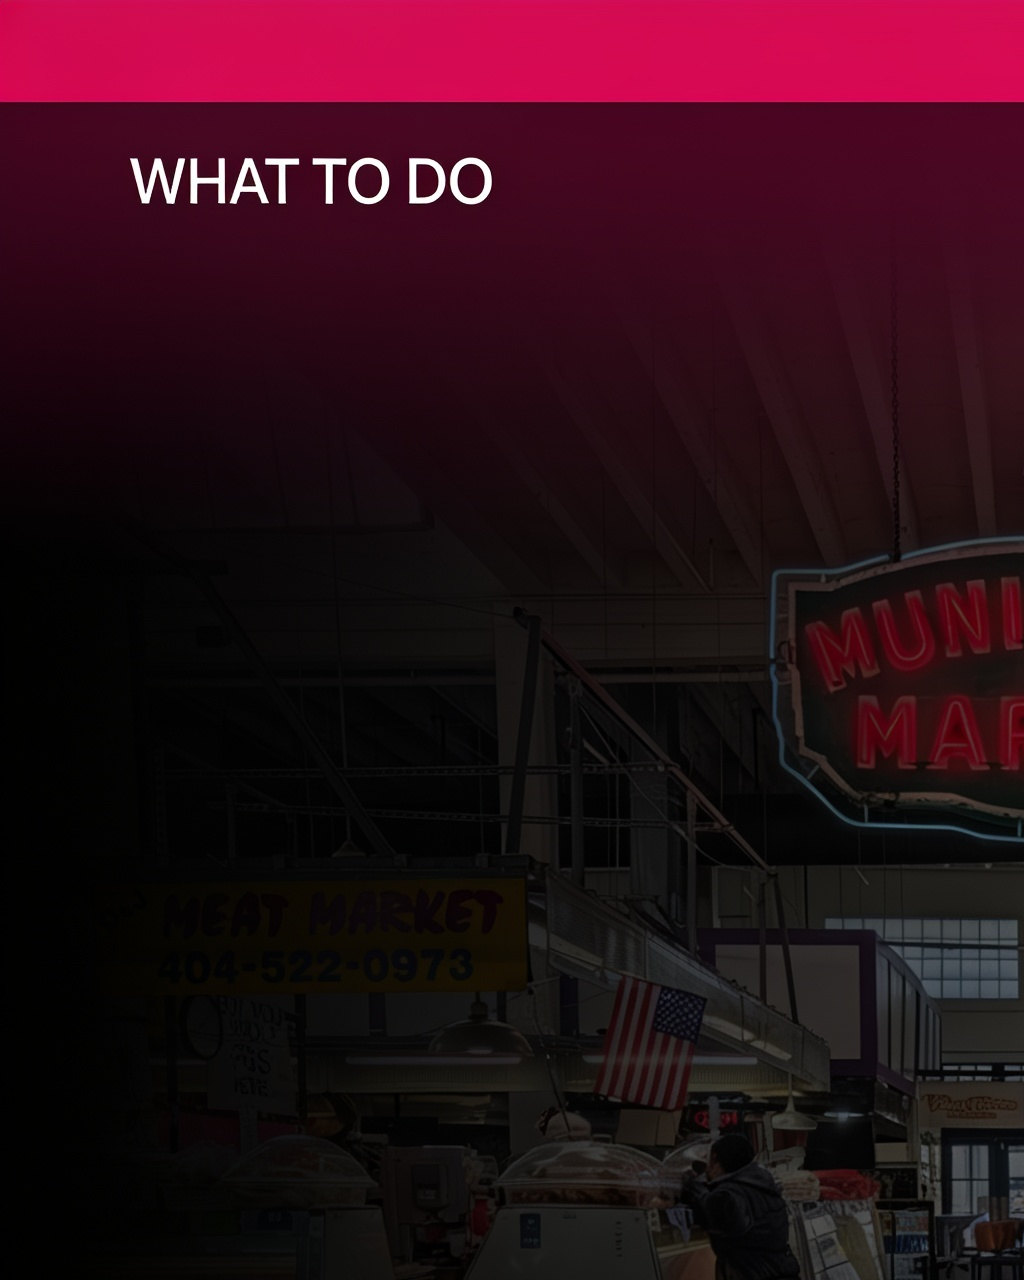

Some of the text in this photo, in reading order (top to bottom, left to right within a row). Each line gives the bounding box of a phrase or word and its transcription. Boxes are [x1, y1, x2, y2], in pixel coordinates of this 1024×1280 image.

[163, 891, 289, 938] MEAT
[308, 889, 504, 936] MARKET
[158, 947, 474, 984] 404-522-0973
